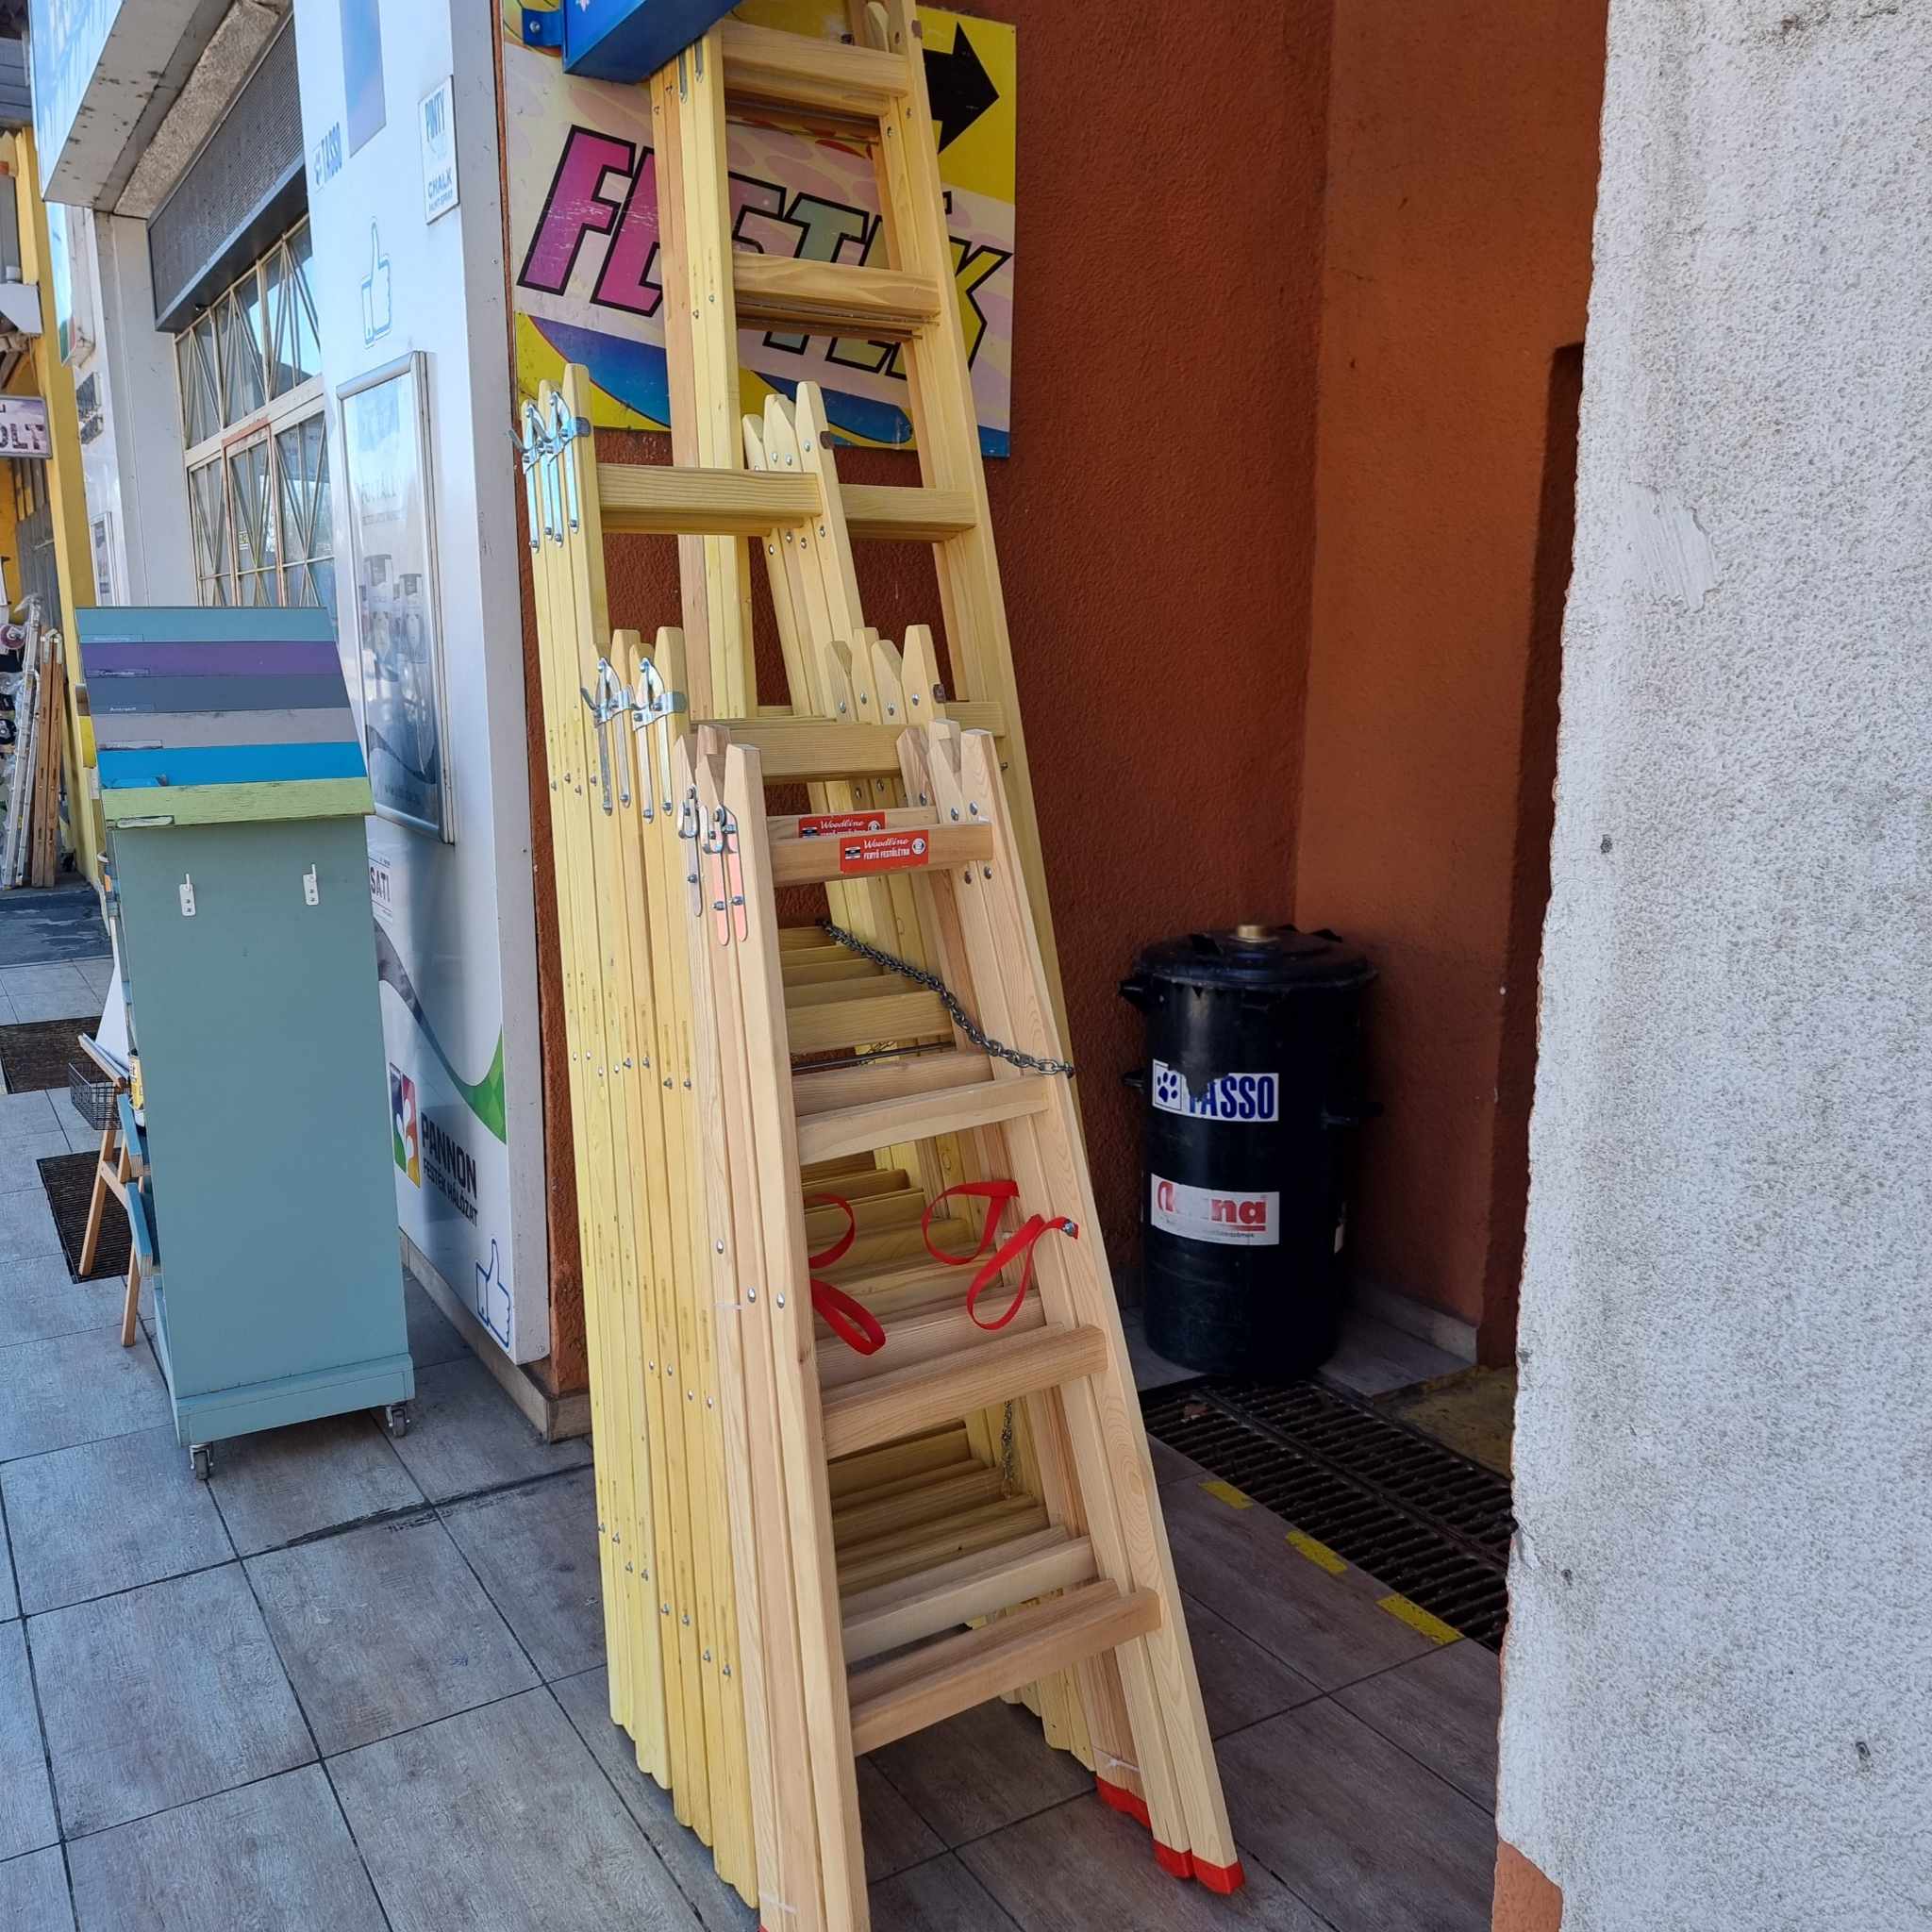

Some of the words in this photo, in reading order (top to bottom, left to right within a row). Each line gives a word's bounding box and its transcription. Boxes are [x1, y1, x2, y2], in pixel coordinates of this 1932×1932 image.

[1190, 1075, 1274, 1120] ASSO
[421, 1111, 477, 1200] PANNON
[446, 1179, 478, 1228] HÁLÓZAT
